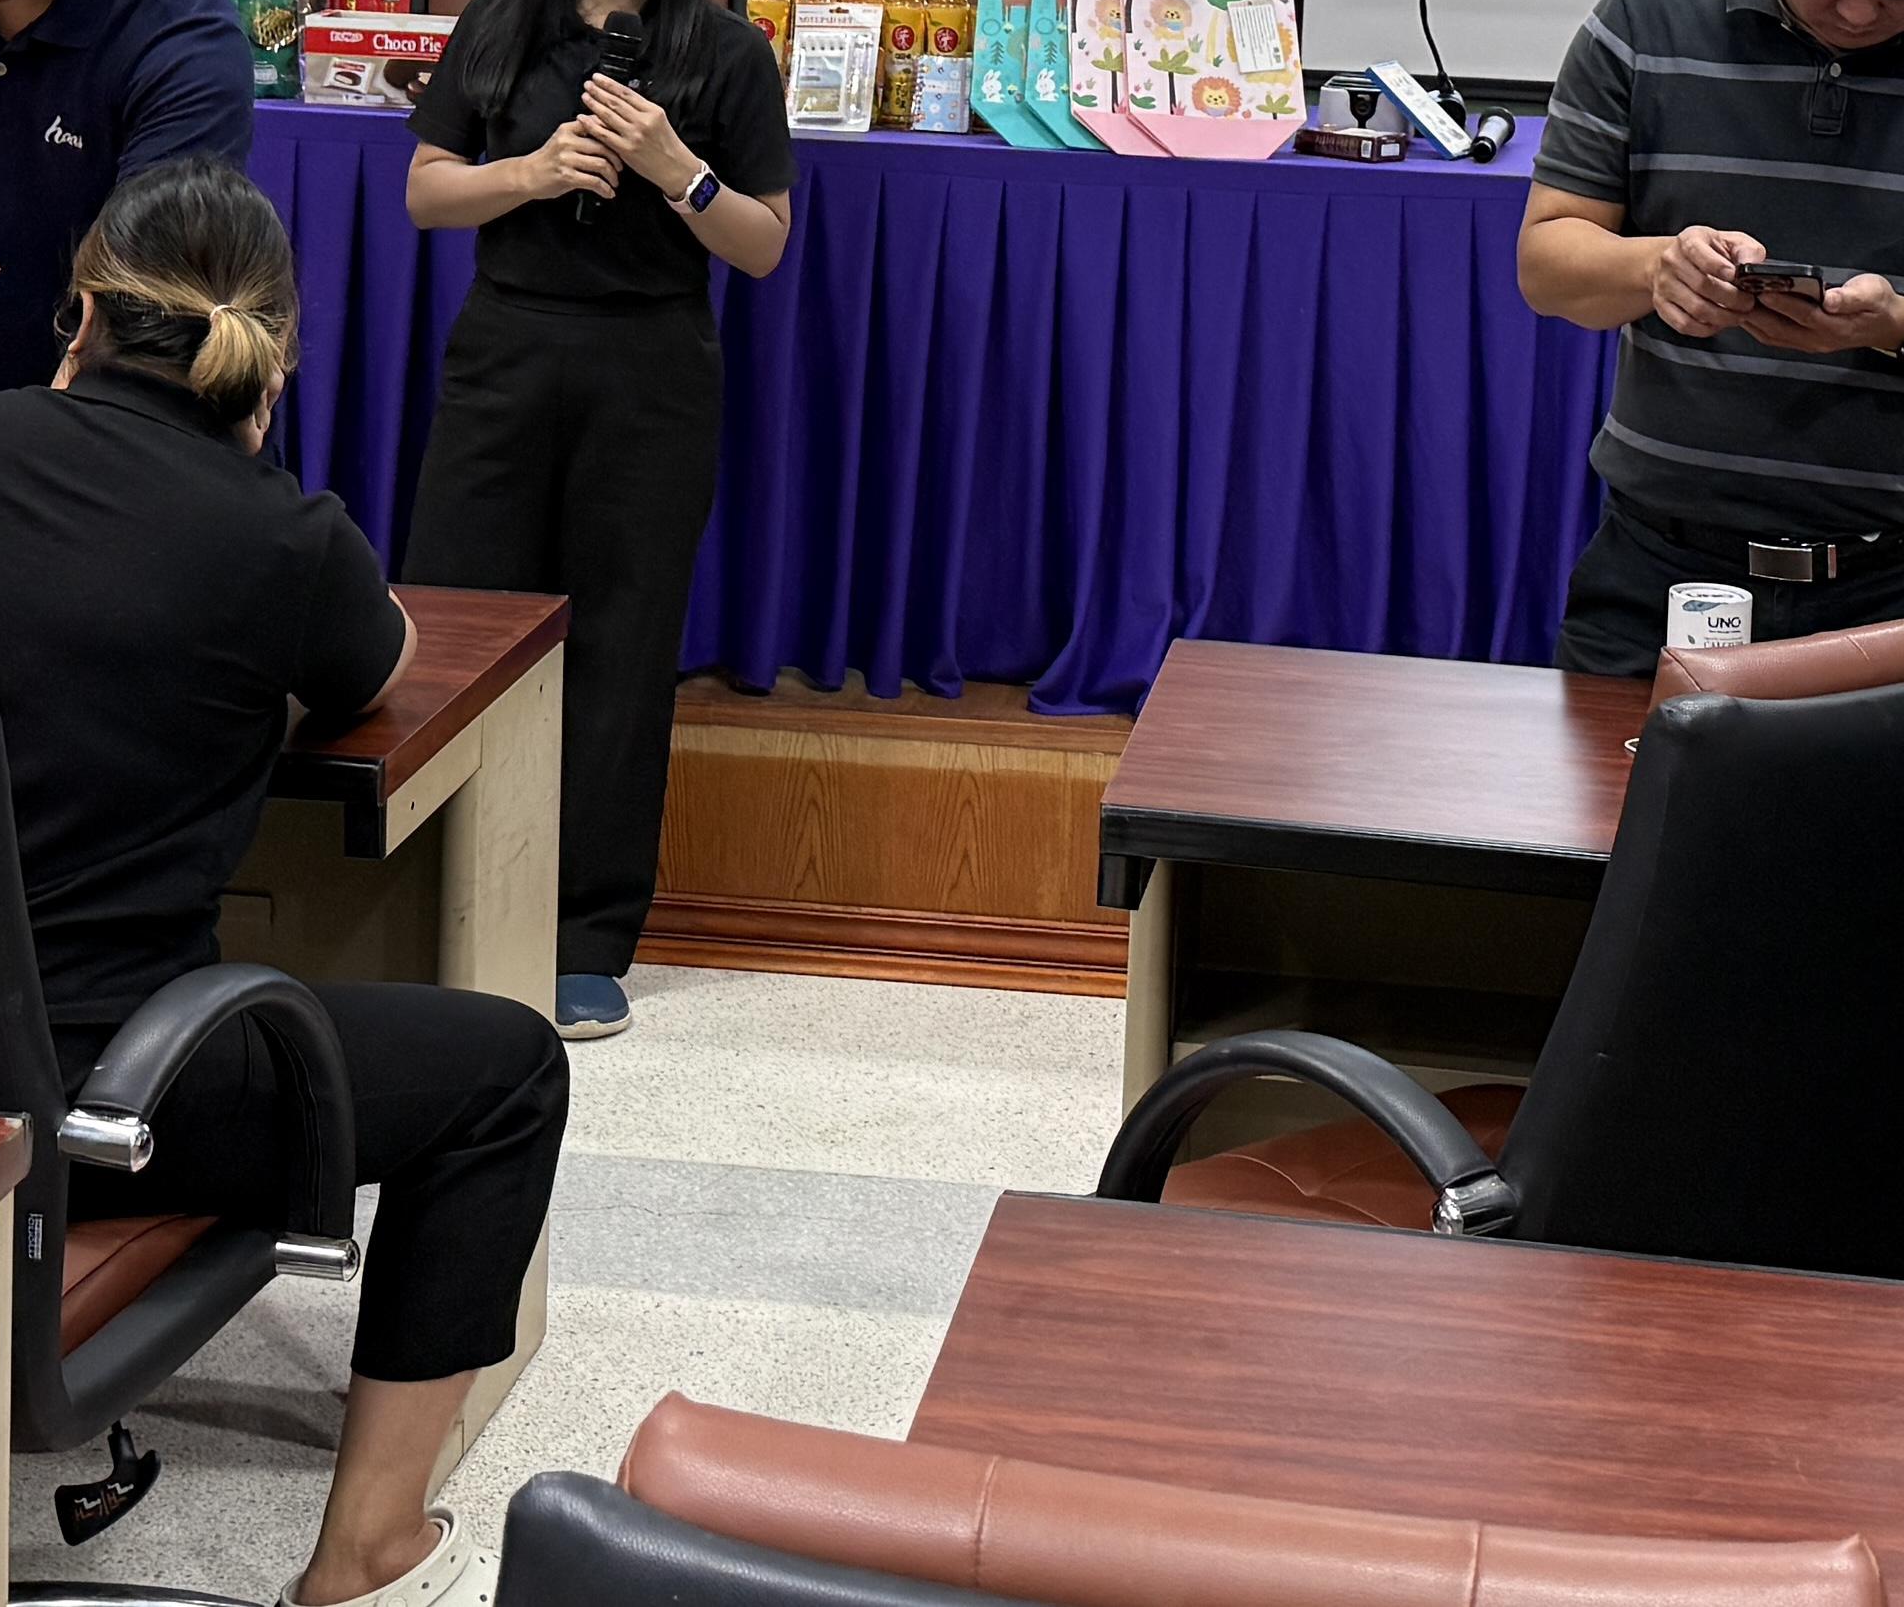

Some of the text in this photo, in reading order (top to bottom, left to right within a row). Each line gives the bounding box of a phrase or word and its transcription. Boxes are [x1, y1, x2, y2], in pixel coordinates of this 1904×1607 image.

[372, 33, 416, 52] Choco
[419, 35, 443, 54] Pie
[1707, 617, 1742, 629] UNO
